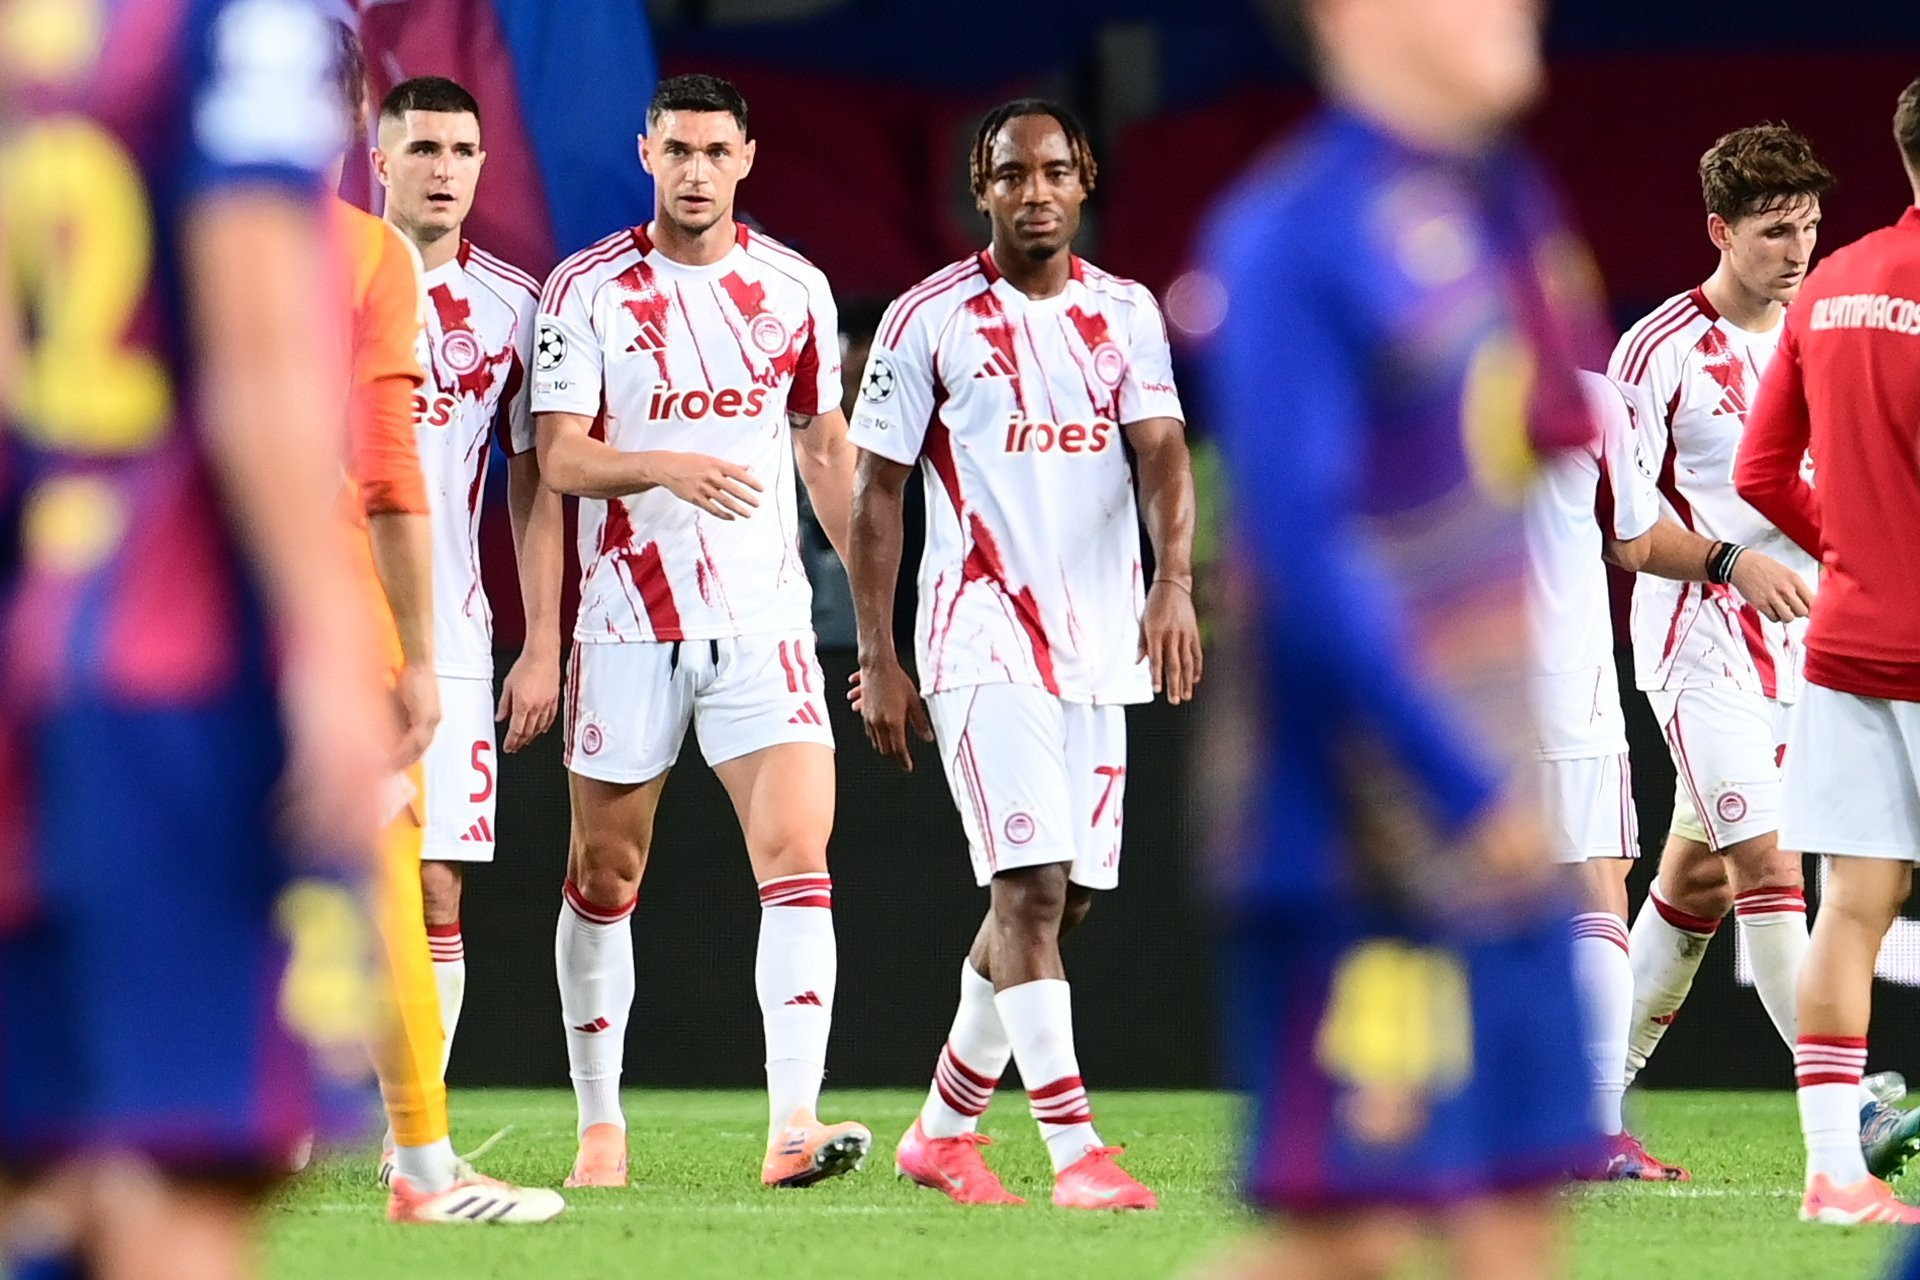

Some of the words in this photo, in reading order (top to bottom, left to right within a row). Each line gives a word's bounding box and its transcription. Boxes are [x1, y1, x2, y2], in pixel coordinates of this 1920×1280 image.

[649, 384, 768, 420] iroes
[1005, 418, 1111, 453] iroes
[779, 639, 812, 693] 11
[469, 740, 493, 803] 5
